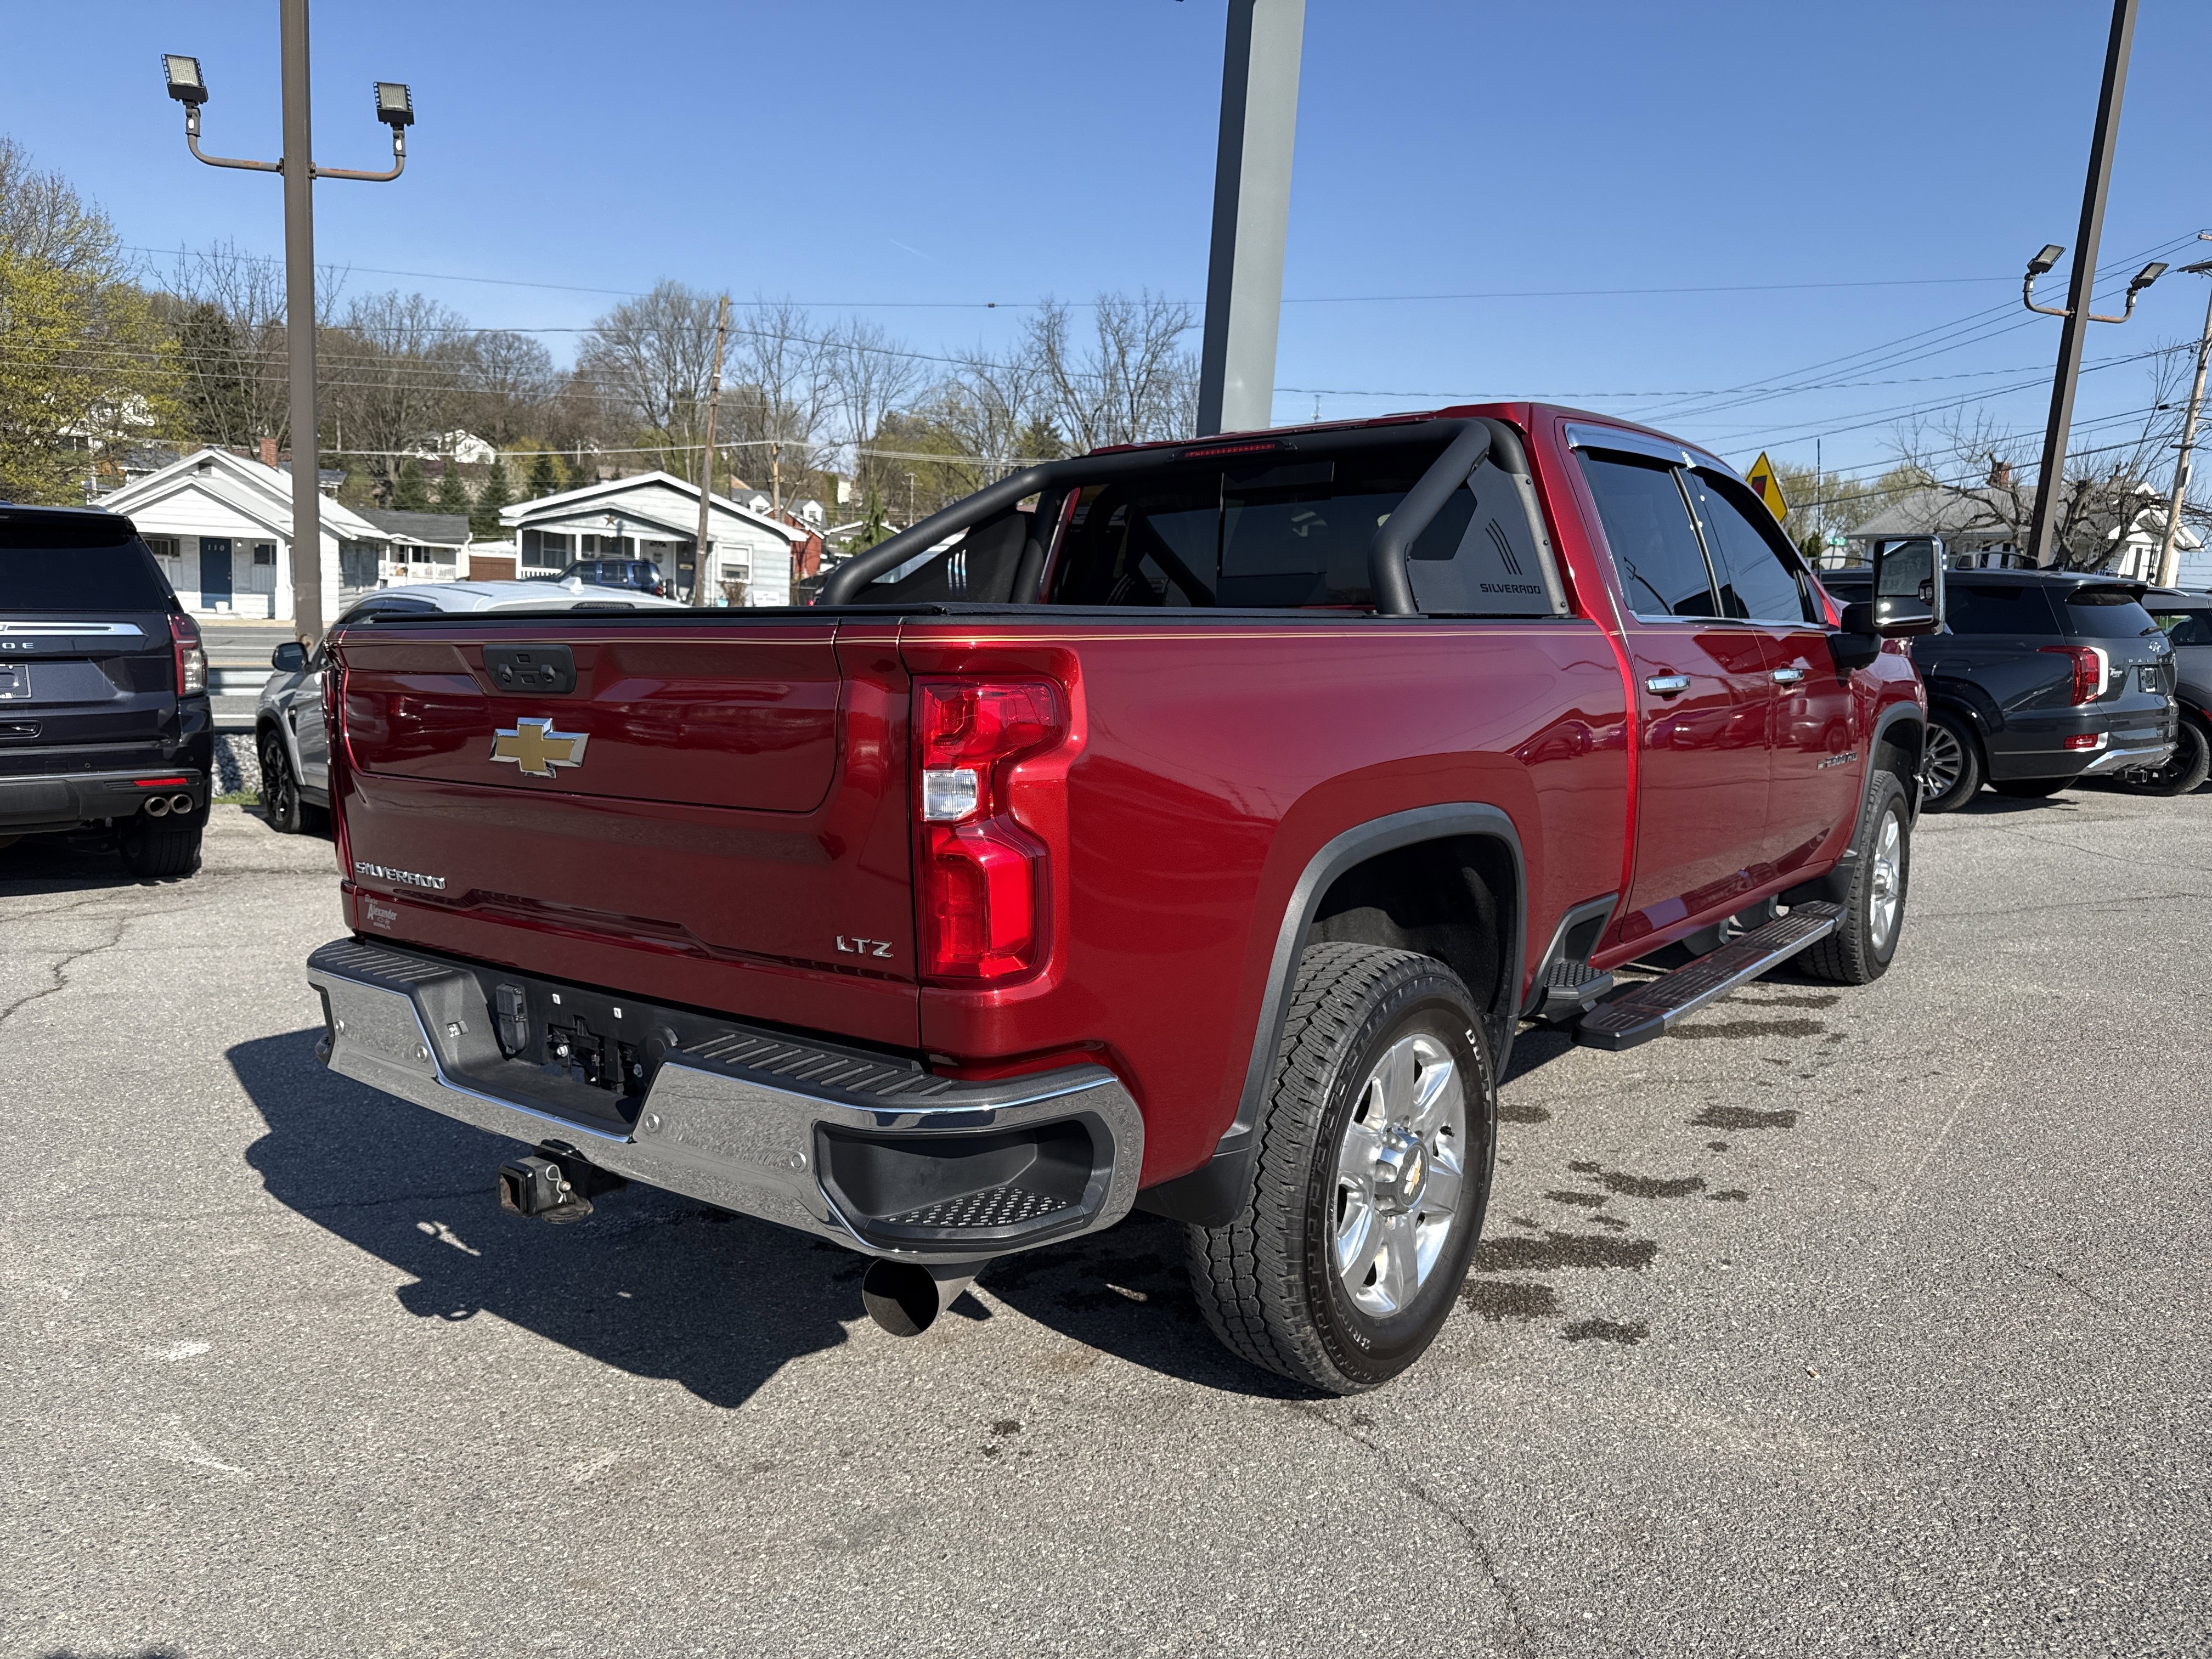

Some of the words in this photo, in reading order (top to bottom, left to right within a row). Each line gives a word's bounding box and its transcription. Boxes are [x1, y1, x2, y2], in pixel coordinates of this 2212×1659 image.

[1480, 583, 1541, 594] SILVERADO
[356, 862, 446, 890] SILVERADO
[367, 904, 397, 921] Alexander
[837, 935, 894, 958] LTZ
